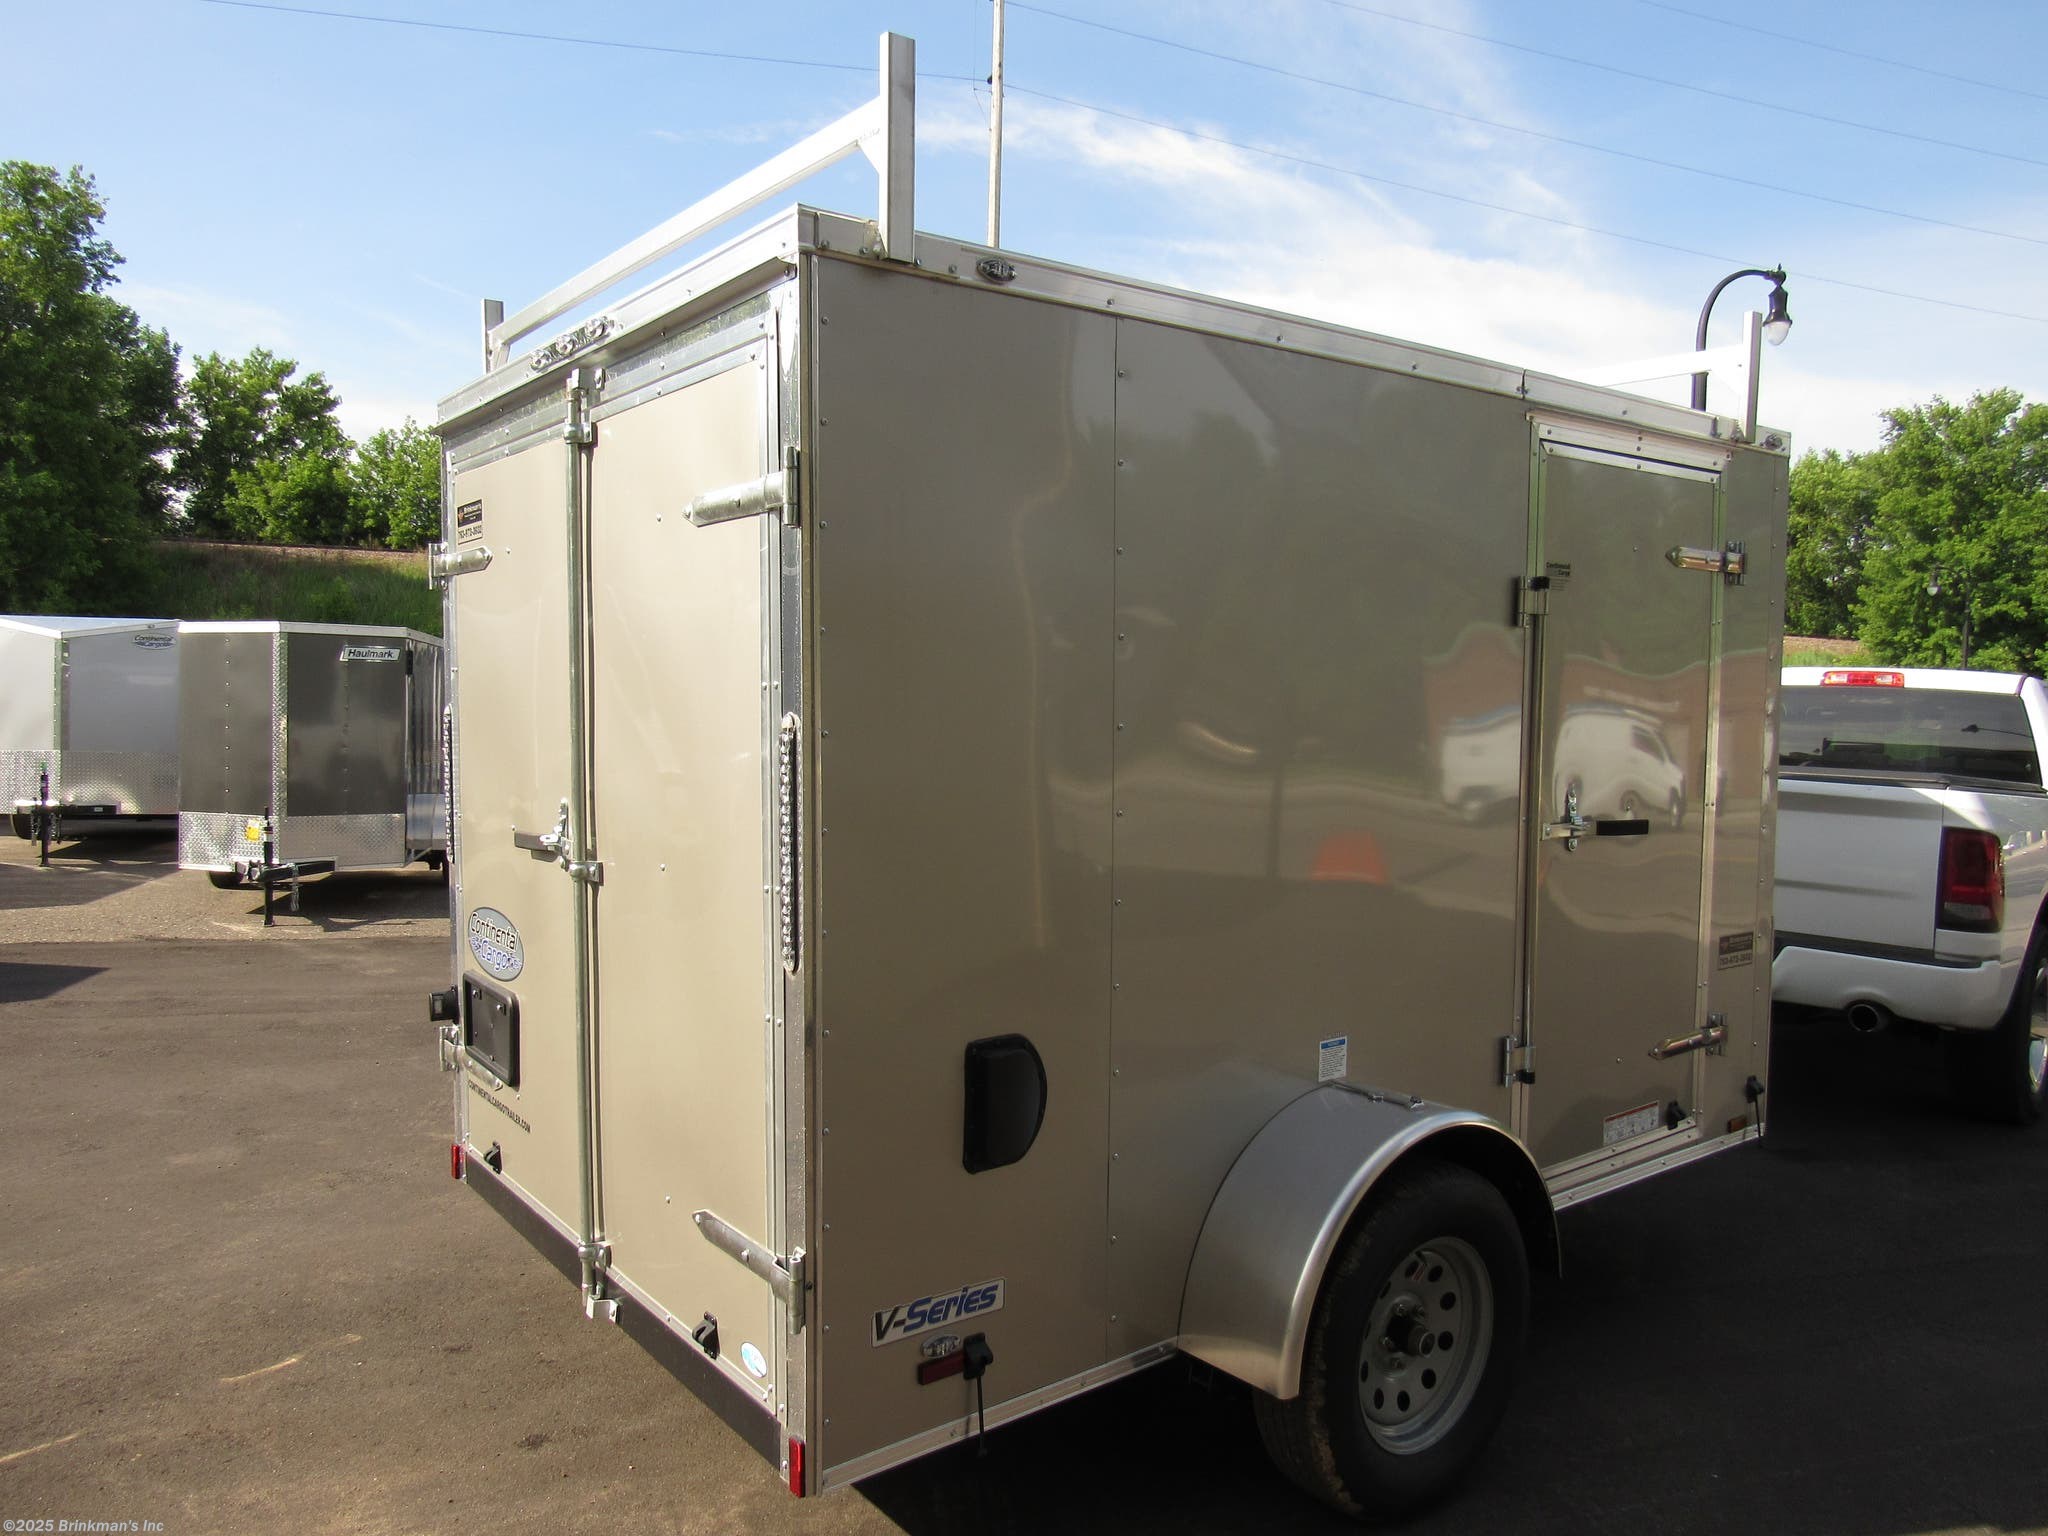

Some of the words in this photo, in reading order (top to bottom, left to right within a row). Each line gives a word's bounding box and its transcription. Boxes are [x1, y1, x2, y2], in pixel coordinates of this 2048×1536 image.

[348, 649, 393, 658] Haulmark
[470, 911, 519, 951] Continental
[481, 939, 508, 971] Cargo
[875, 1285, 999, 1341] V-Series
